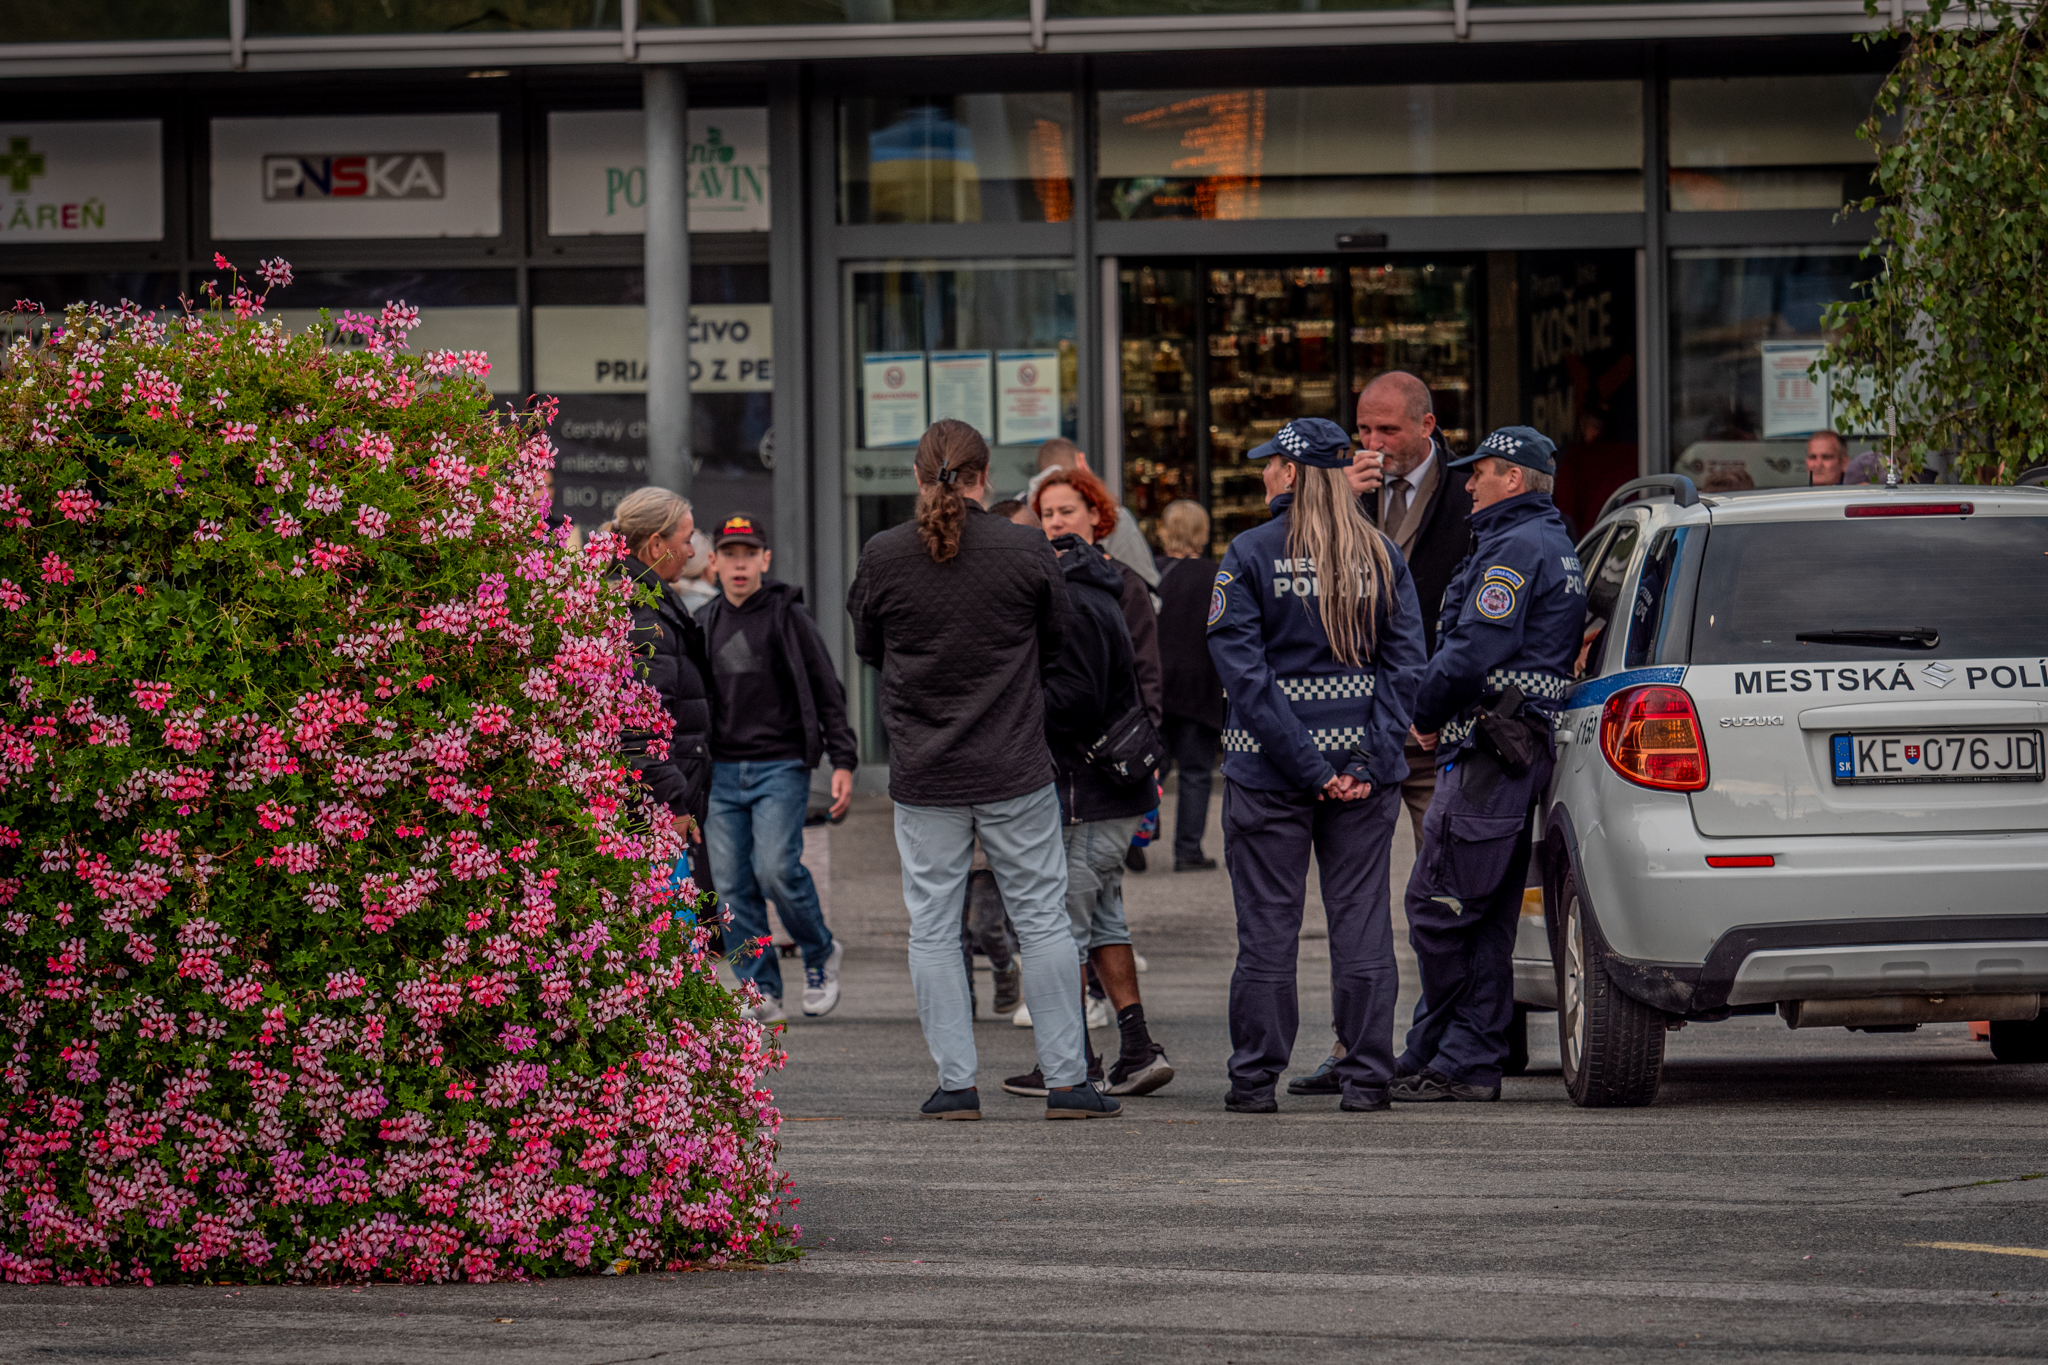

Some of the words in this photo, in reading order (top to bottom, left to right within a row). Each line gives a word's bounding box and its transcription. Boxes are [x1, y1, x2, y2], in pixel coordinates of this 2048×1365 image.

[266, 157, 441, 197] PNSKA
[712, 359, 727, 381] Z
[1734, 663, 1915, 695] MESTSKÁ
[1719, 715, 1784, 728] SUZUKI
[1838, 761, 1851, 772] SK
[1858, 739, 1902, 773] KE
